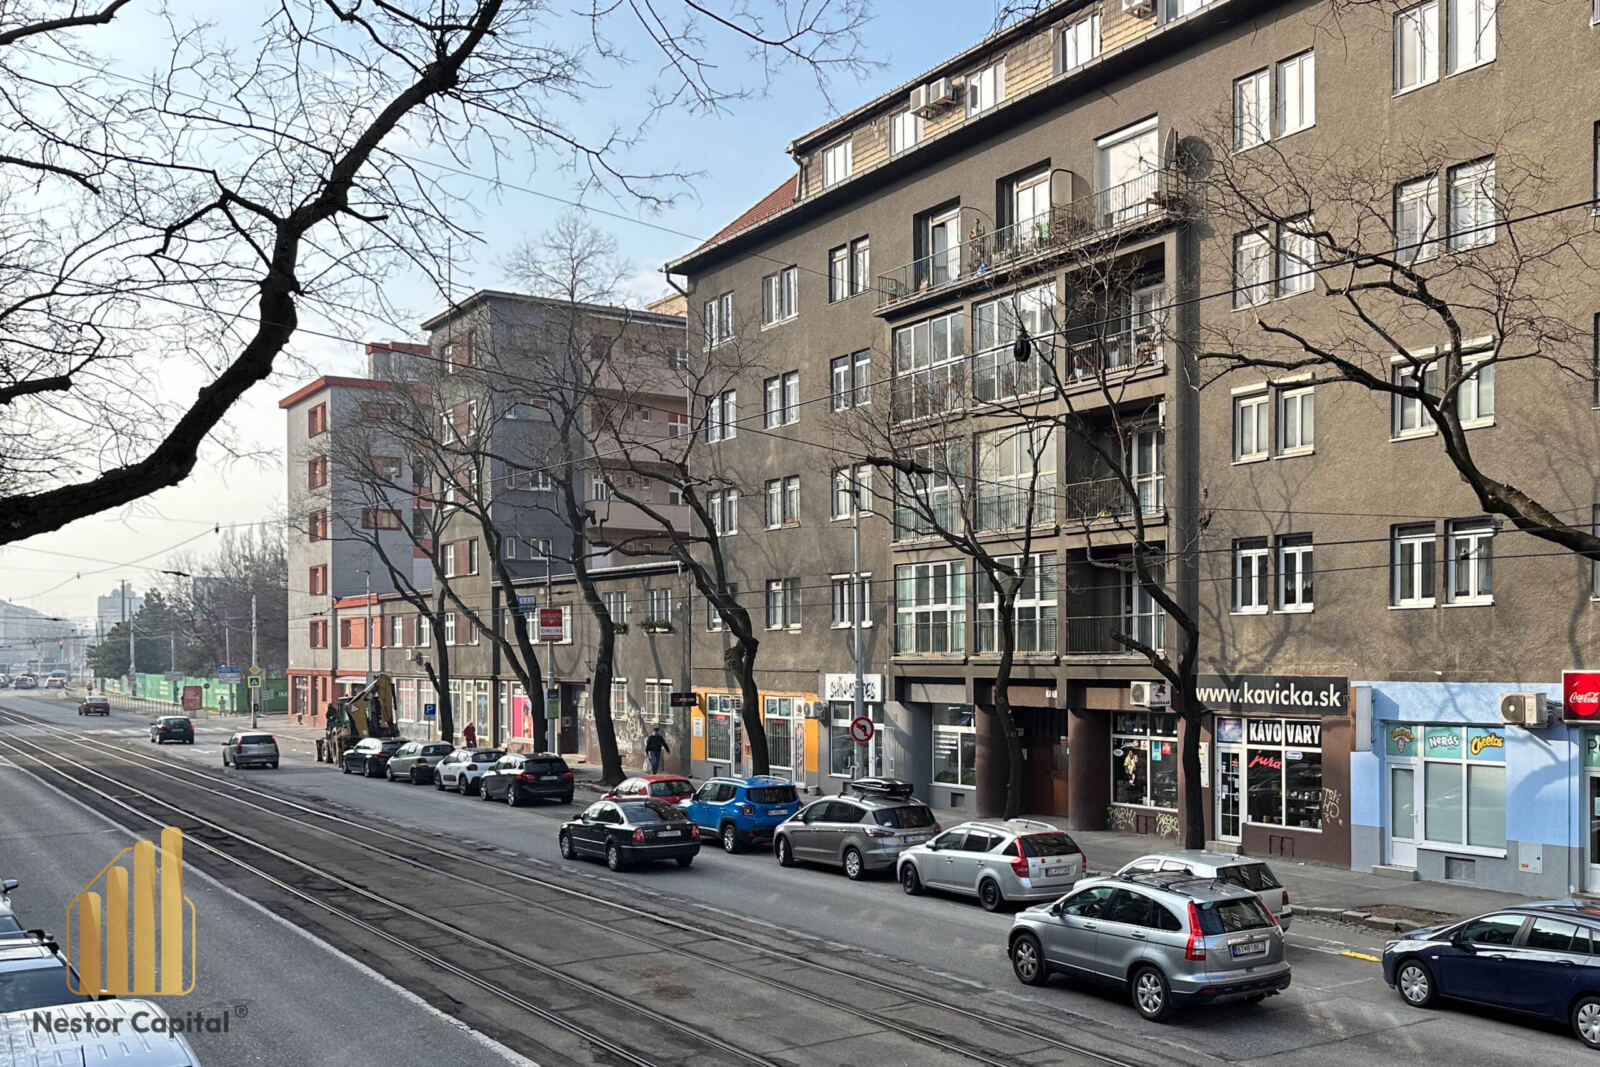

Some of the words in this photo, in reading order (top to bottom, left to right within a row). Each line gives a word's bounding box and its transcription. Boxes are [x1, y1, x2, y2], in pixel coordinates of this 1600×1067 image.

[1196, 681, 1342, 708] www.kavicka.sk
[1569, 691, 1599, 704] Coca-Cola
[426, 705, 434, 714] P
[1470, 733, 1505, 755] Cheetos
[1248, 750, 1282, 770] jura
